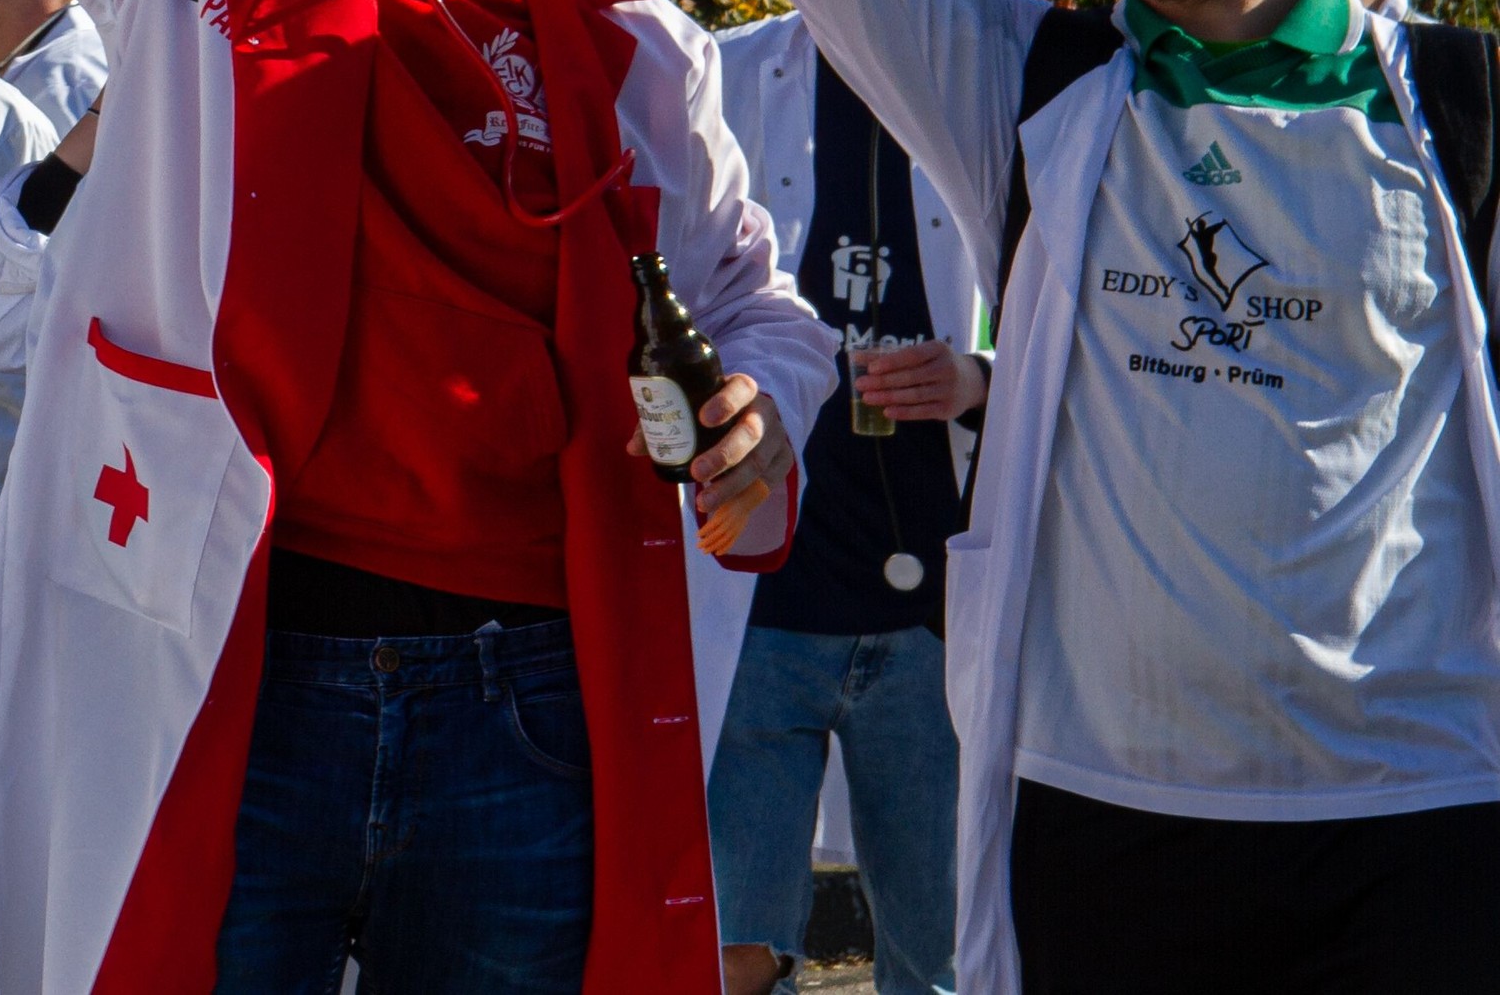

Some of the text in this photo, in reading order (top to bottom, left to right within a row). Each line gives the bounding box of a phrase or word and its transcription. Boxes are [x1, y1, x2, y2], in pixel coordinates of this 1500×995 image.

[1182, 168, 1243, 186] adidas
[1246, 295, 1324, 322] SHOP
[1170, 315, 1266, 353] SPORT
[1128, 353, 1285, 390] Bitburg Prüm
